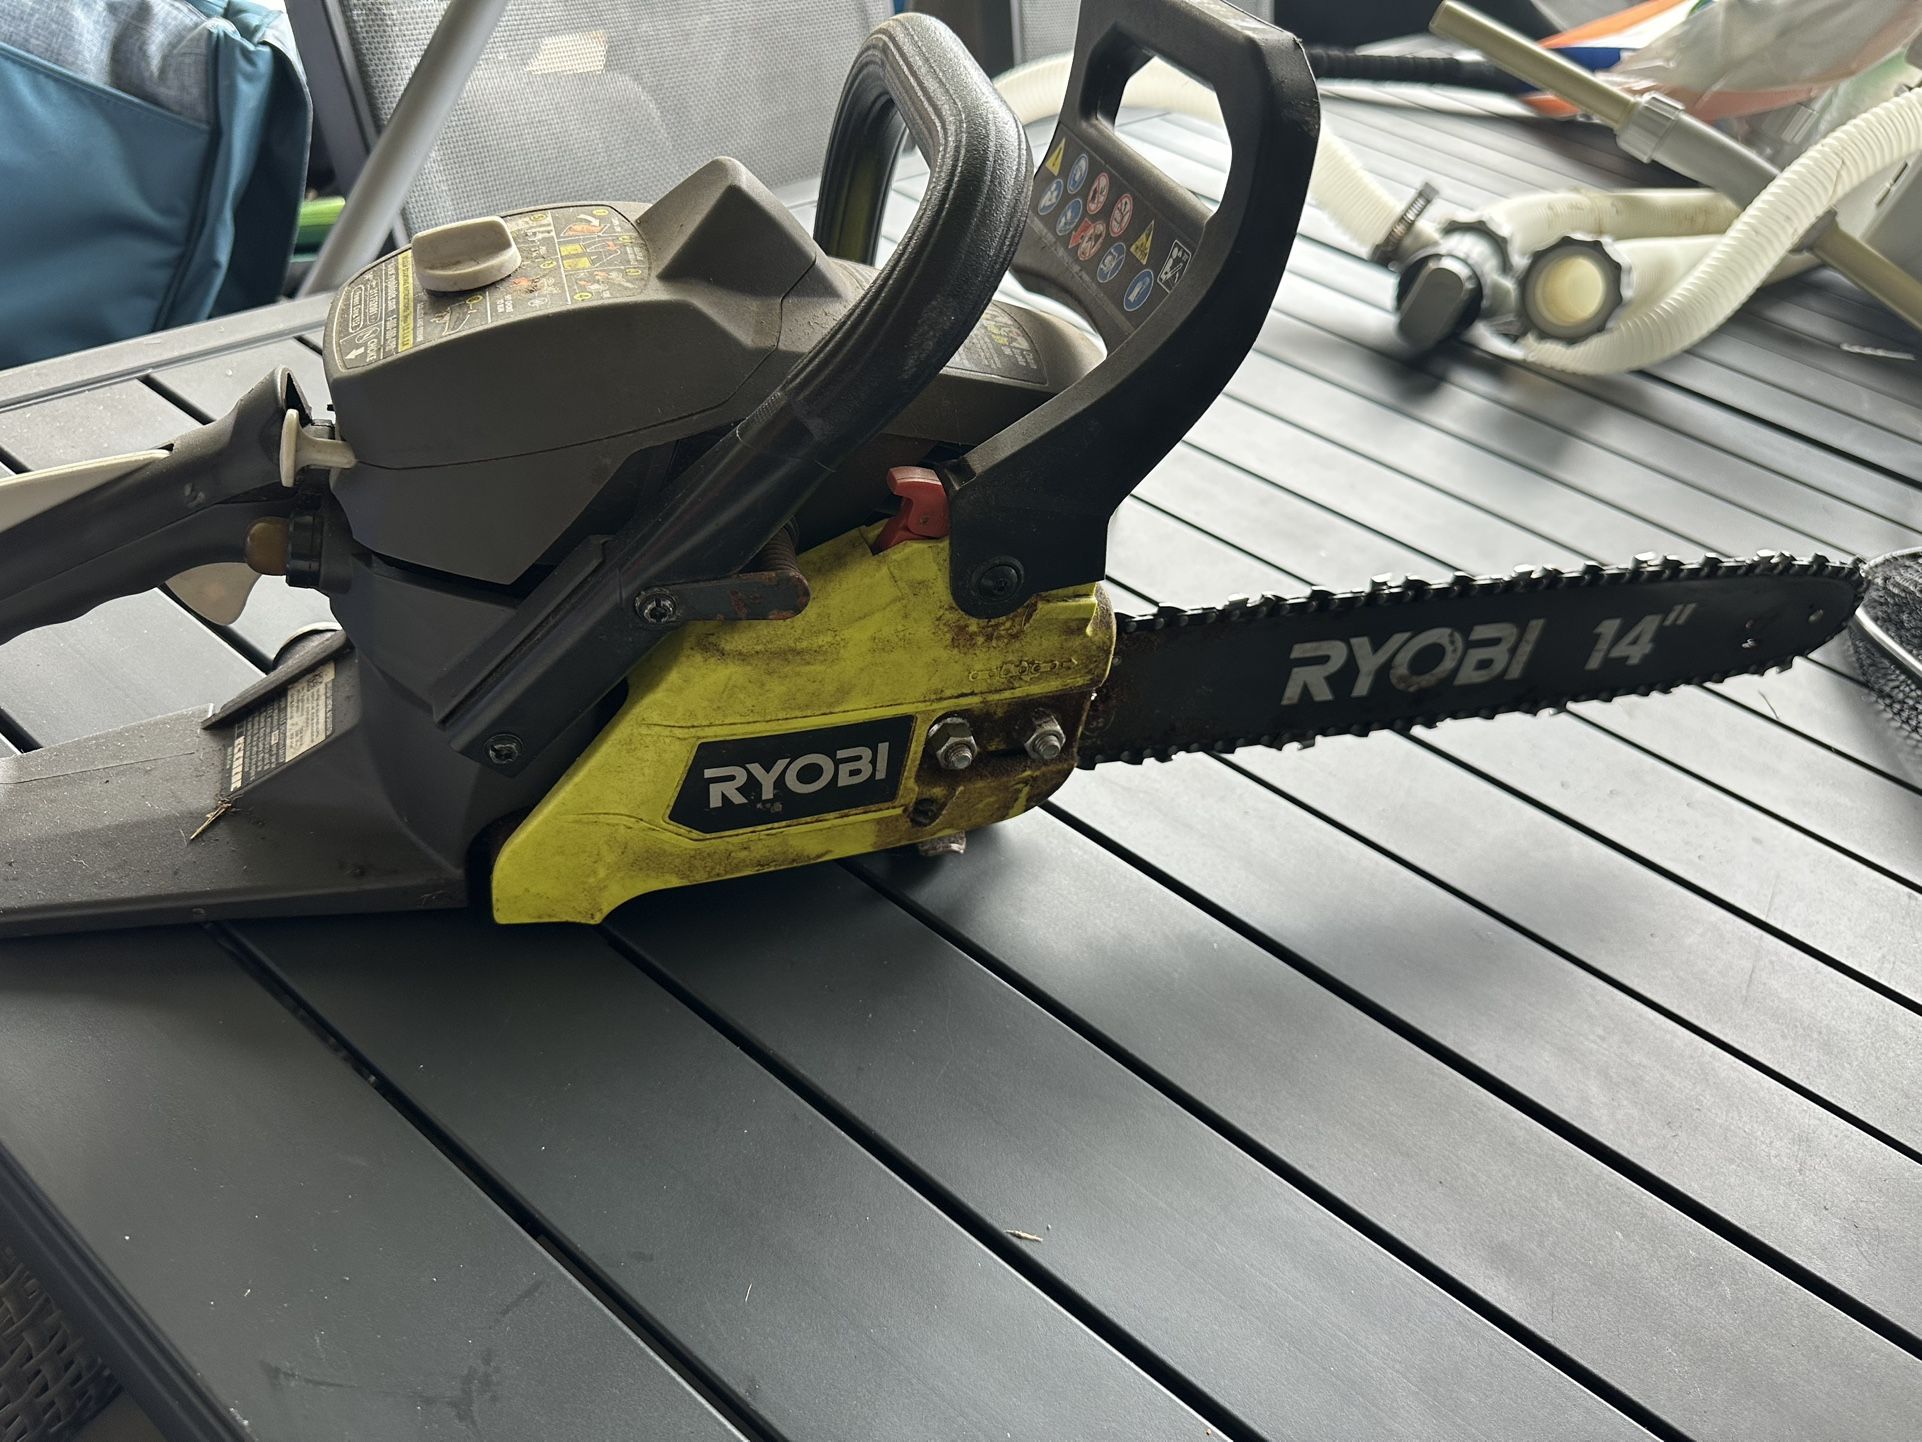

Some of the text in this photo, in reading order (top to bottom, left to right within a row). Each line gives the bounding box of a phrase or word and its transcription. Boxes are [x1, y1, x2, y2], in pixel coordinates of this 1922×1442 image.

[366, 338, 376, 363] CHOKE
[1280, 618, 1547, 706] RYOBI
[703, 741, 890, 809] RYOBI
